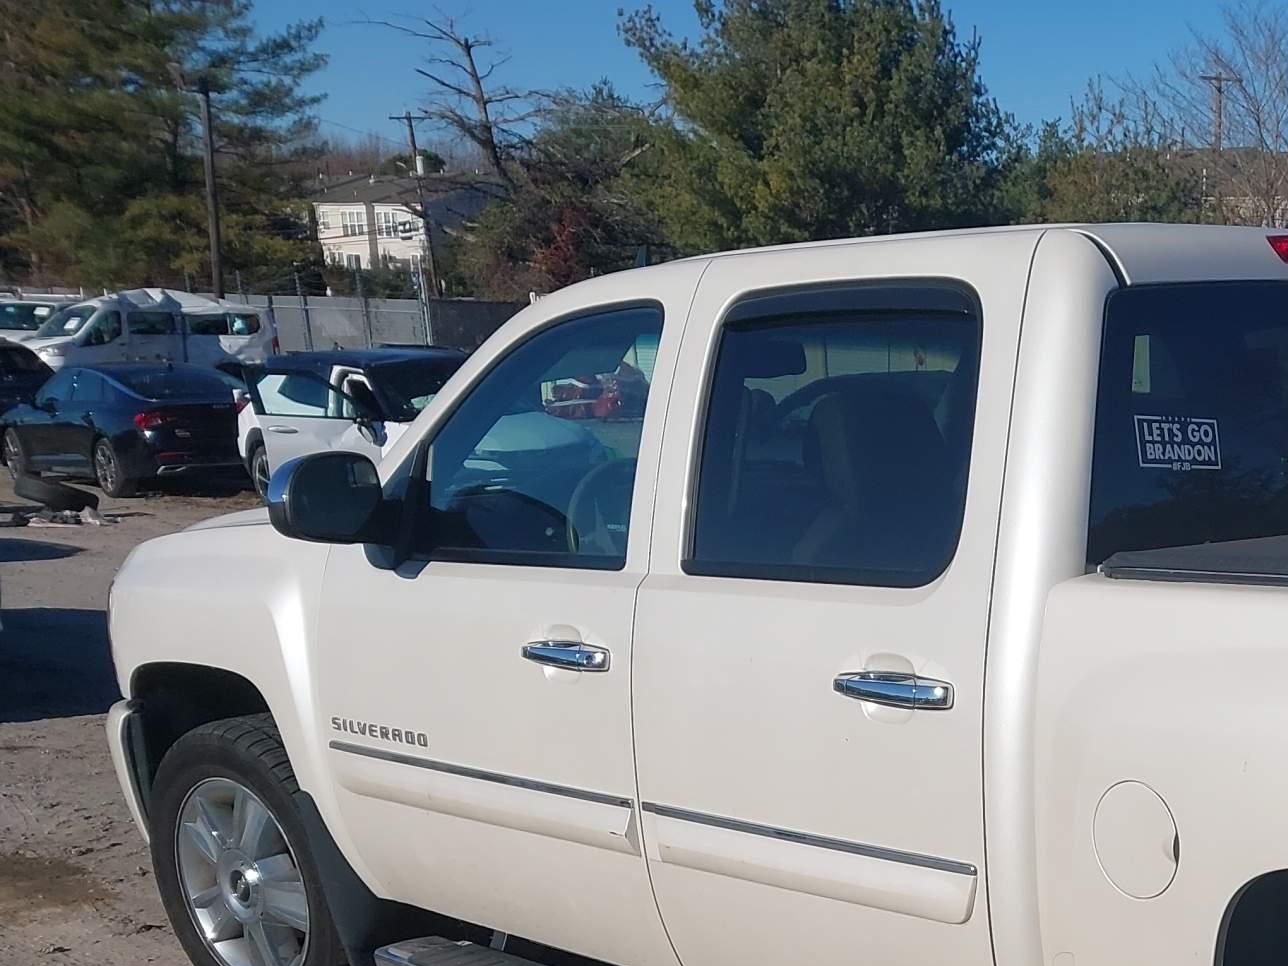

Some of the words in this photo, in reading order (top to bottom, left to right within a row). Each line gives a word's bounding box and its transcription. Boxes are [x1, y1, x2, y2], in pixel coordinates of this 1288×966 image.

[1143, 422, 1182, 442] LET'S
[1187, 423, 1213, 443] GO
[1145, 443, 1216, 461] BRANDON
[331, 716, 428, 747] SILVERADO
